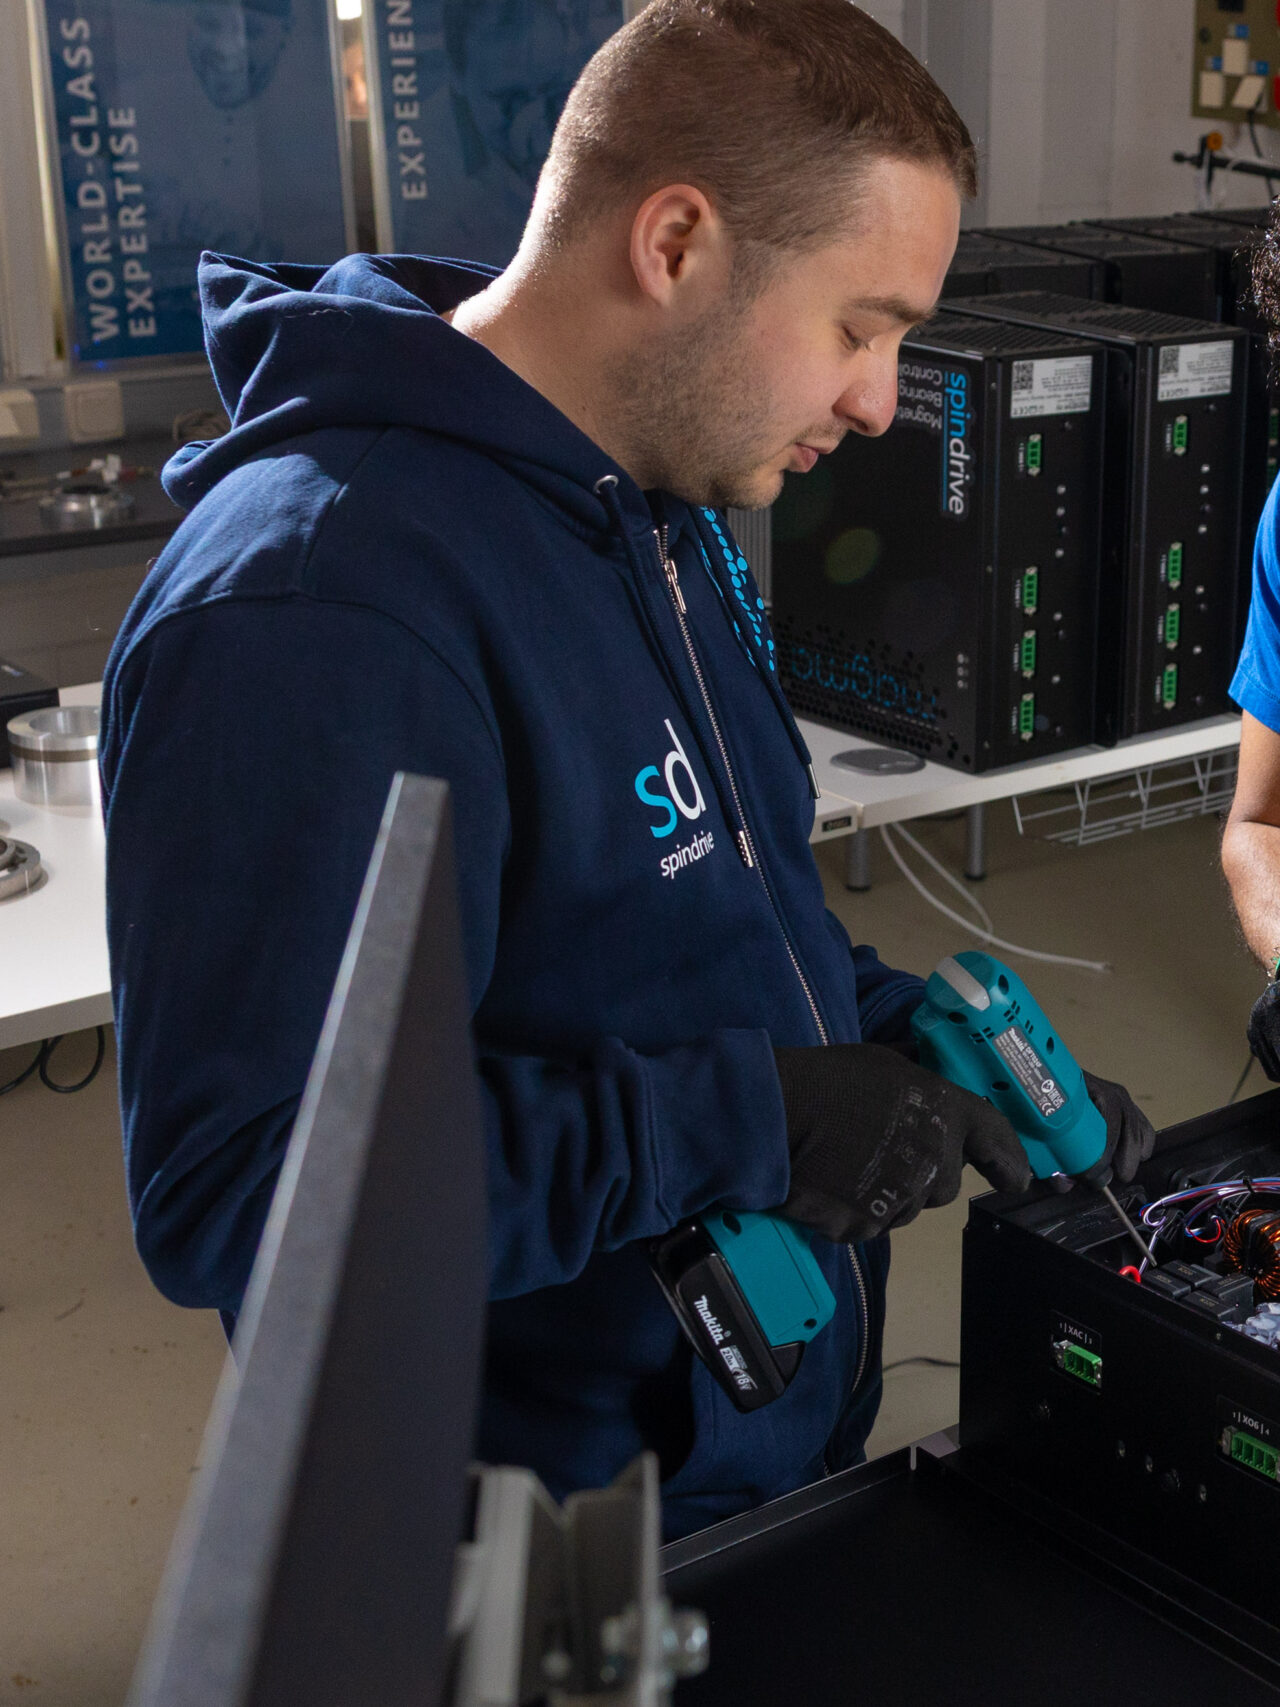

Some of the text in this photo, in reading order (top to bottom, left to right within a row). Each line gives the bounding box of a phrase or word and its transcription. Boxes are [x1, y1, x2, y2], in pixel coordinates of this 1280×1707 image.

[60, 15, 121, 342] WORLD-CLASS
[107, 106, 158, 338] EXPERTISE
[899, 379, 943, 408] Bearing
[945, 372, 972, 515] spindrive
[634, 717, 708, 840] sd
[693, 1293, 725, 1346] makita
[1067, 1324, 1085, 1341] XAC
